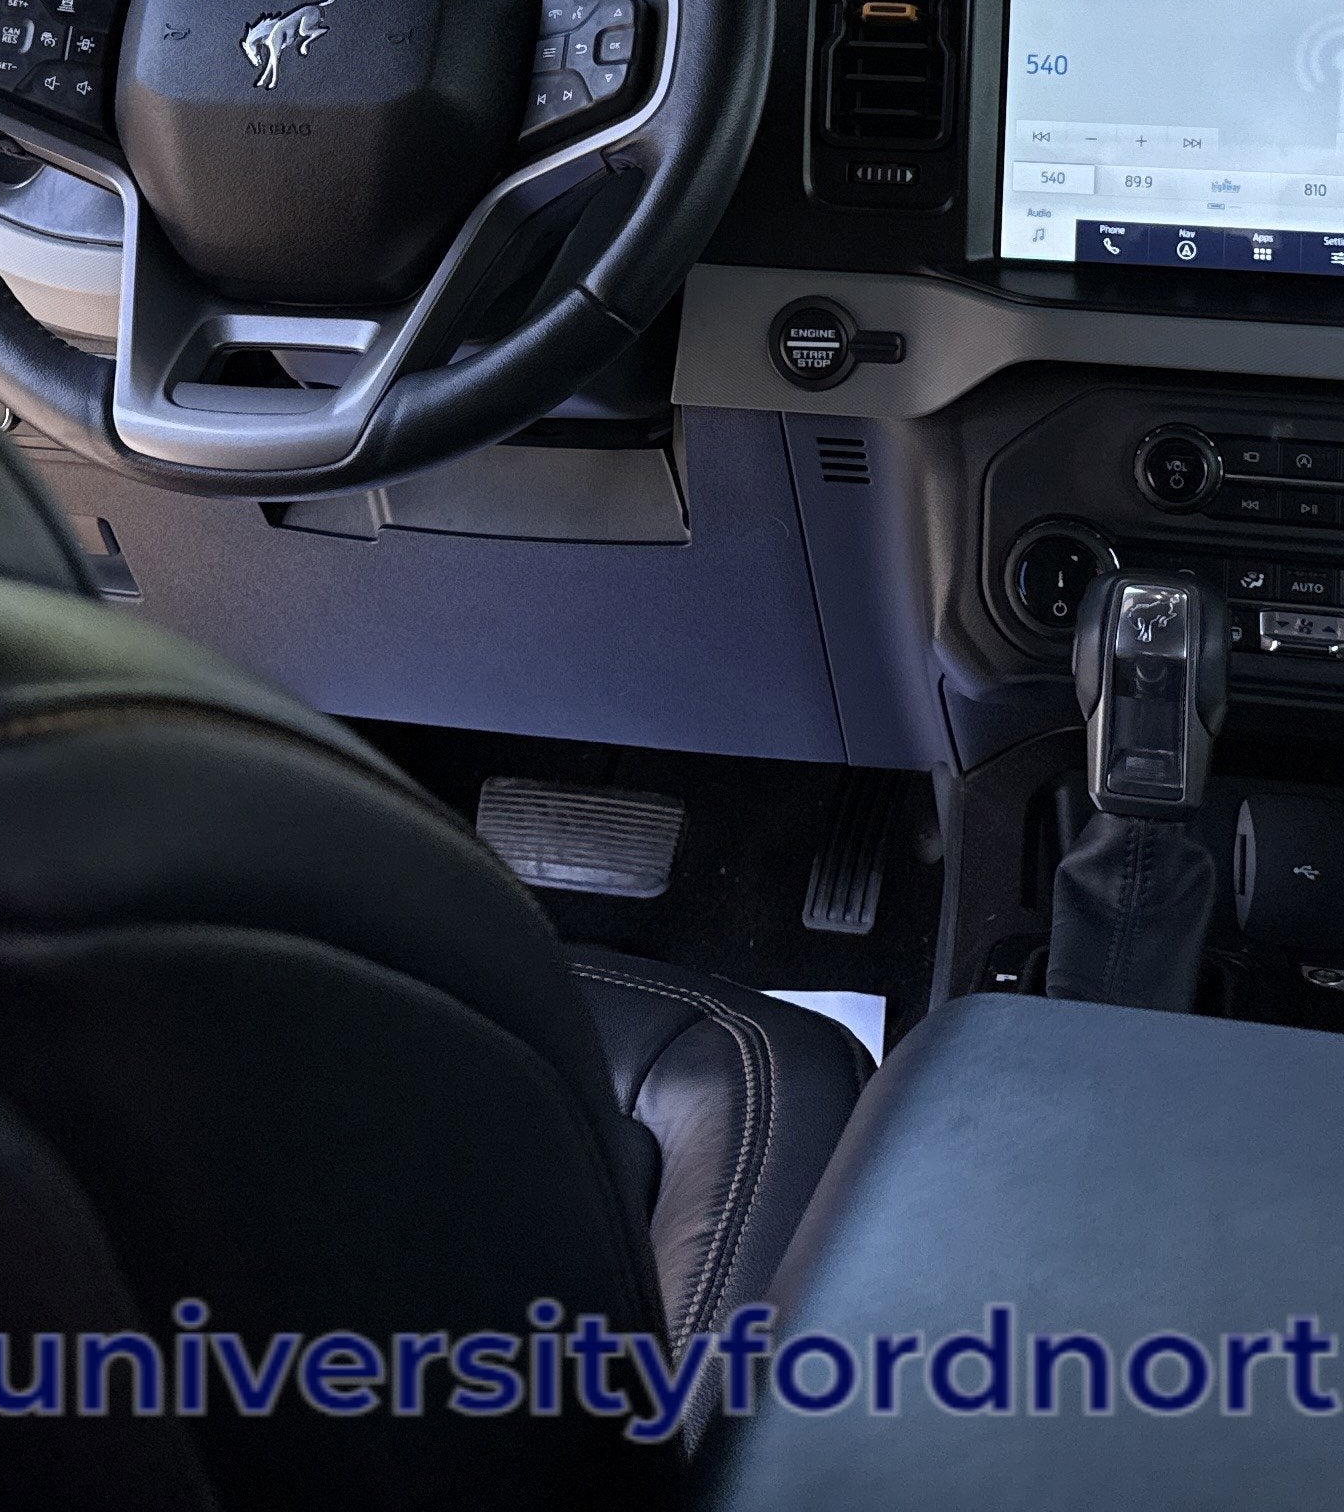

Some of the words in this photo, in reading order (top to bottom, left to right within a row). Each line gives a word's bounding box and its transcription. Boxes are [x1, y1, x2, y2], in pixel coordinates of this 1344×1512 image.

[3, 27, 21, 36] CAN
[1, 35, 18, 45] RES
[609, 42, 621, 50] OK
[1026, 54, 1069, 76] 540
[245, 121, 311, 136] AIRBAG
[1040, 171, 1066, 185] 540
[1125, 175, 1153, 188] 89.9
[1303, 184, 1327, 197] 810
[1026, 207, 1052, 218] Audio
[1099, 224, 1125, 235] Phone
[1179, 228, 1196, 238] Nav
[1252, 232, 1274, 244] Apps
[790, 328, 836, 338] ENGINE
[793, 350, 834, 360] START
[797, 359, 831, 368] STOP
[1166, 461, 1187, 472] VOL
[1291, 582, 1323, 594] AUTO
